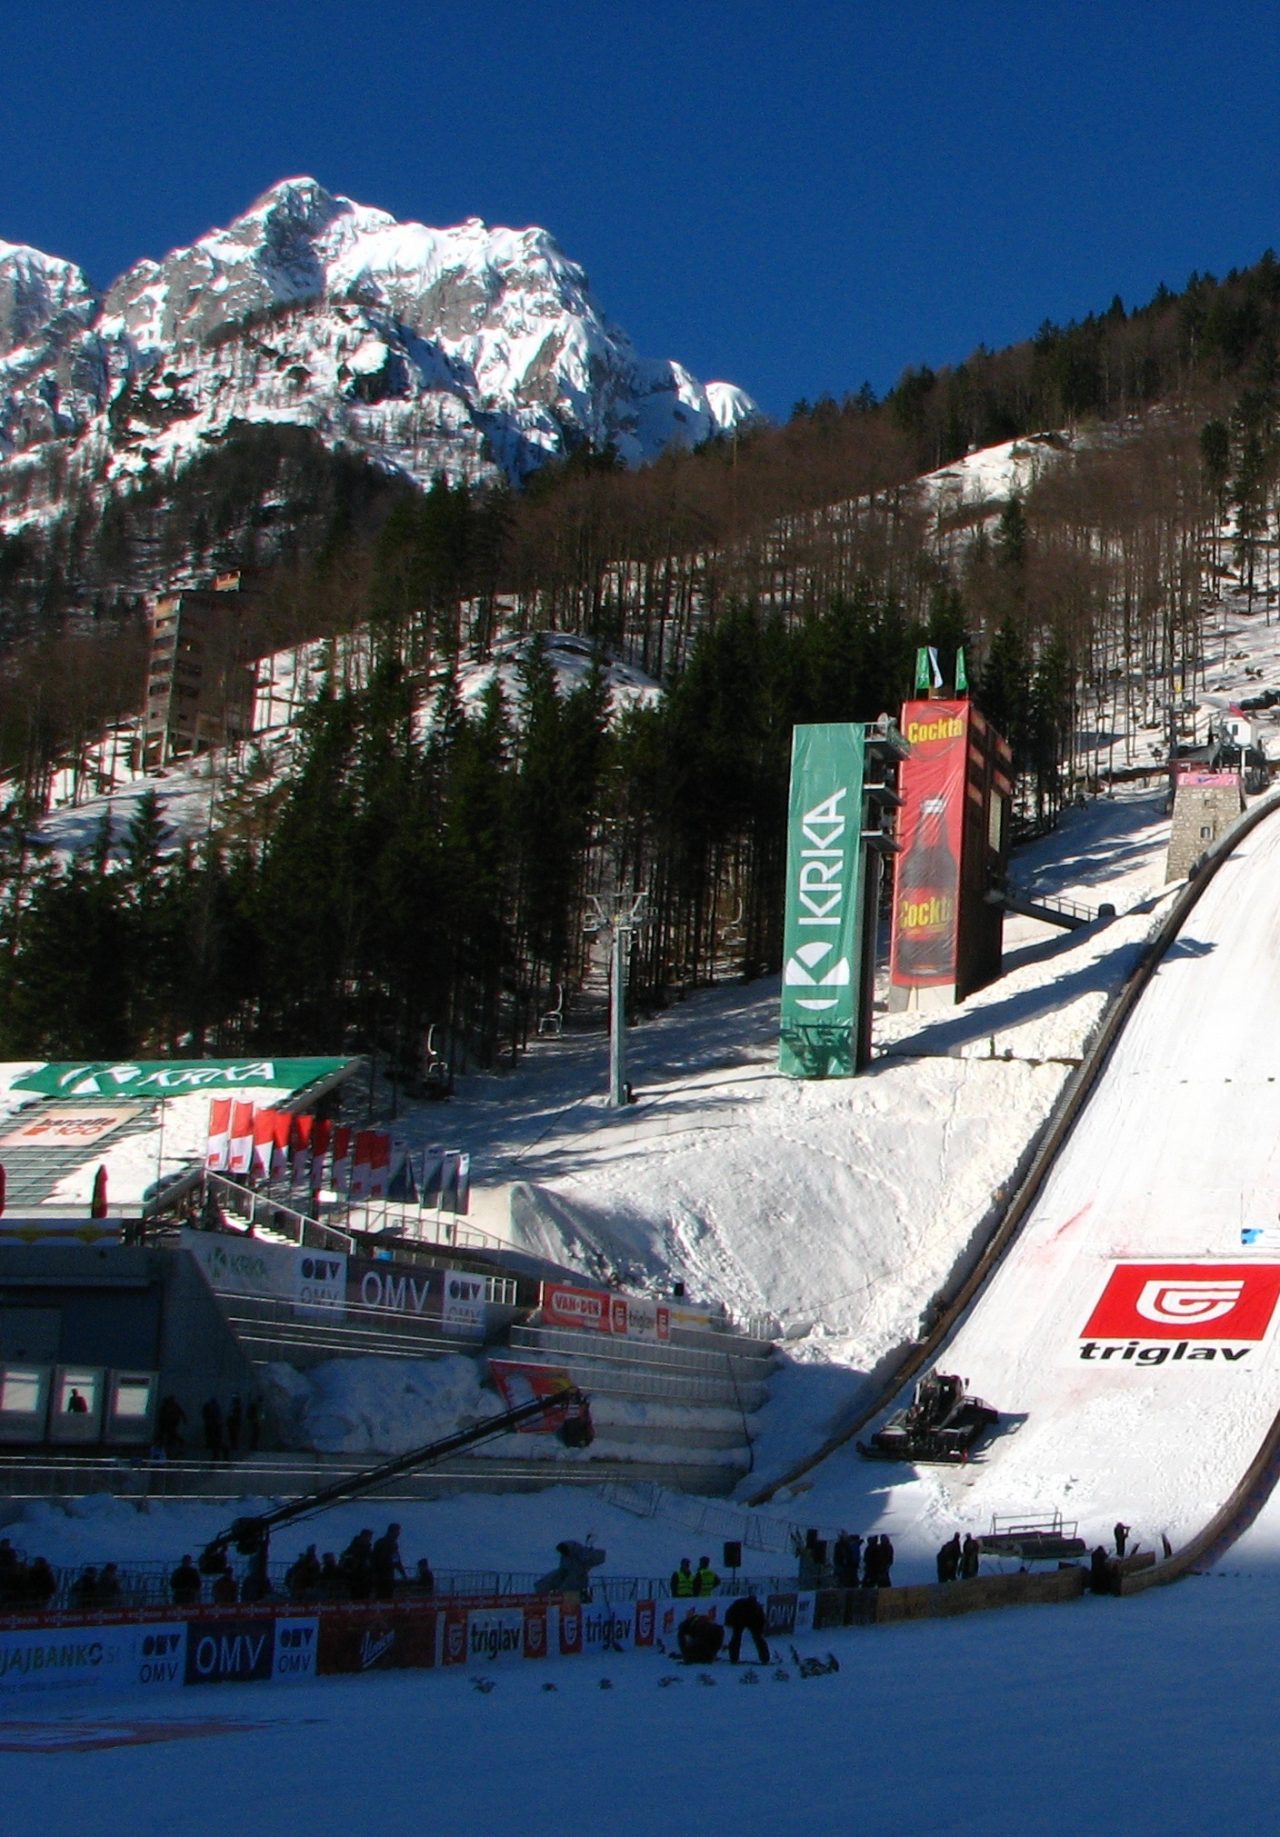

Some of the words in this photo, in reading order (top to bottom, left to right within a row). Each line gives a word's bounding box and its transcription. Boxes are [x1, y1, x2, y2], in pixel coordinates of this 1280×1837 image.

[907, 716, 964, 747] Cockta
[798, 787, 847, 925] KRKA
[136, 1062, 275, 1087] KRKA
[361, 1271, 431, 1315] OMV
[1080, 1342, 1251, 1367] triglav
[471, 1621, 521, 1659] triglav
[586, 1614, 632, 1649] triglav
[196, 1634, 266, 1675] OMV
[278, 1654, 311, 1673] OMV
[140, 1663, 178, 1683] OMV
